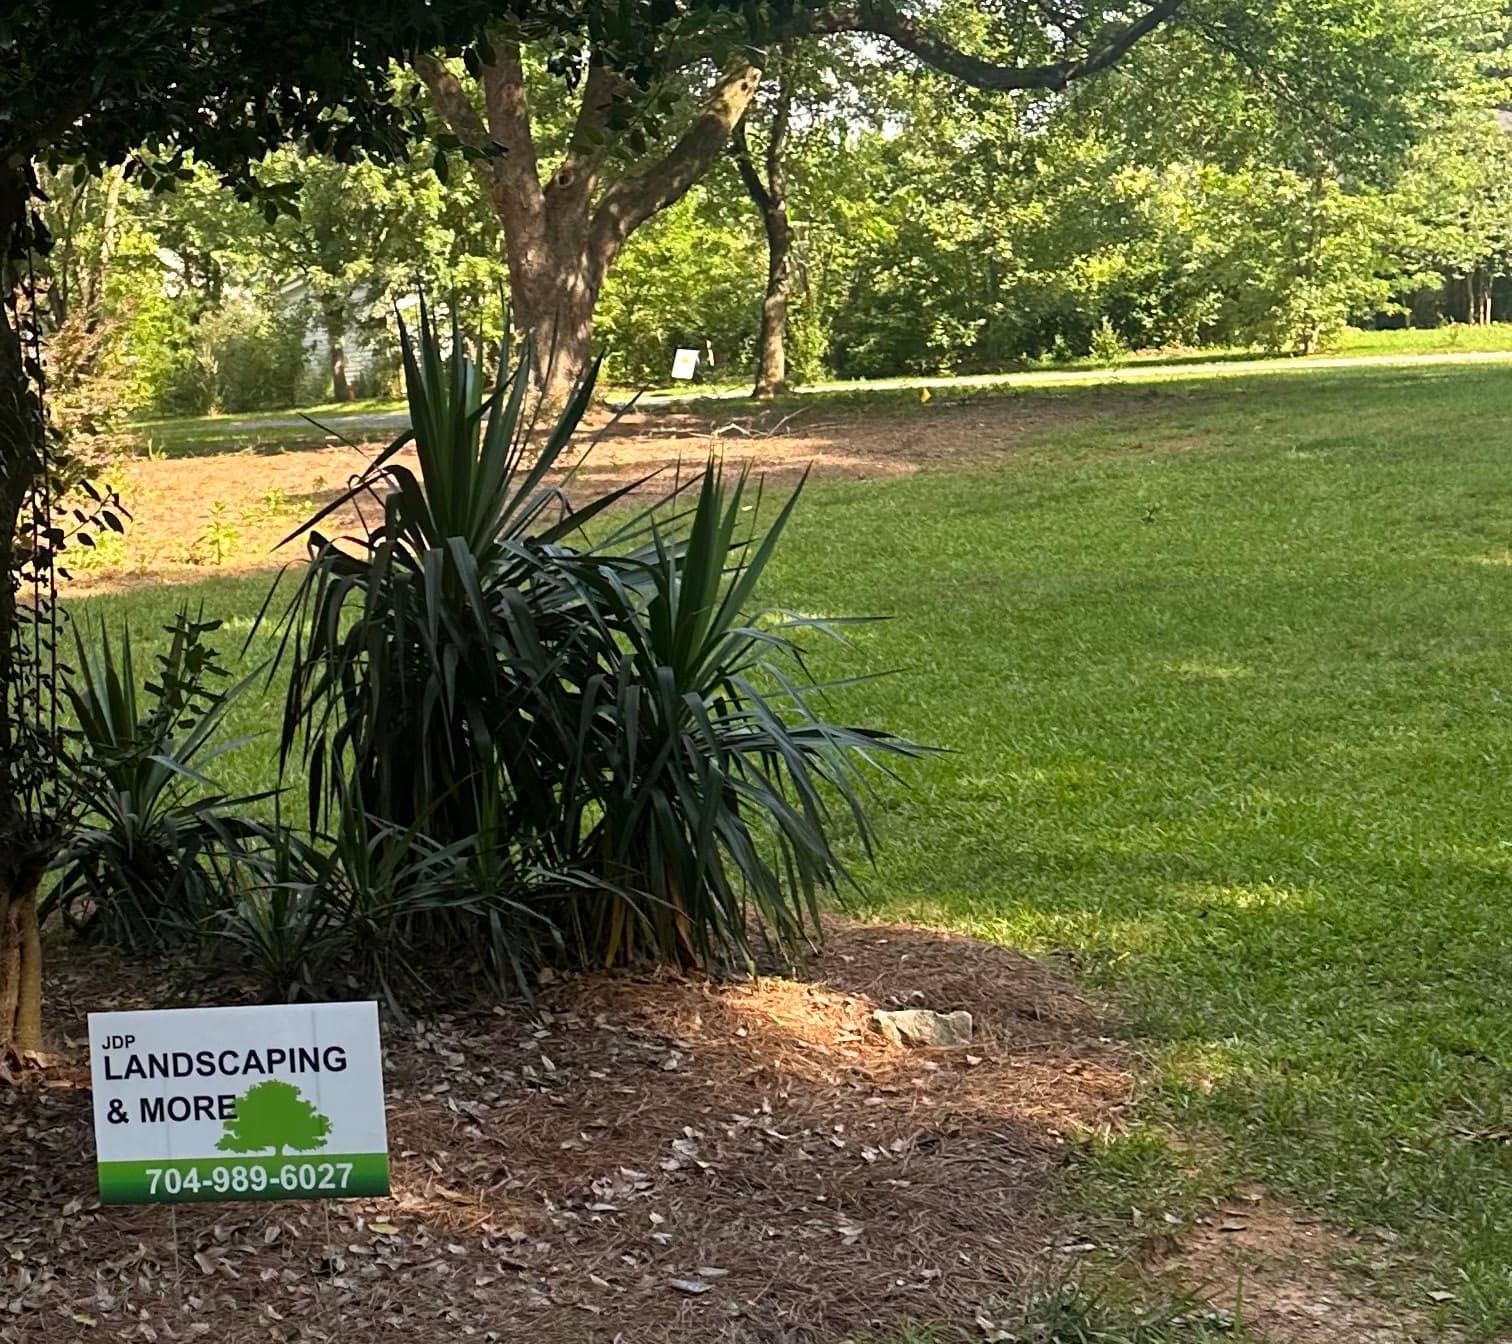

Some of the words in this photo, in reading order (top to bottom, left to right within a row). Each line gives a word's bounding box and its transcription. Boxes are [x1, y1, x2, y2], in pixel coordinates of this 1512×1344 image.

[102, 1035, 136, 1050] JDP
[103, 1046, 348, 1081] LANDSCAPING
[106, 1098, 130, 1124] &
[140, 1094, 238, 1123] MORE
[145, 1163, 354, 1195] 704-989-6027
